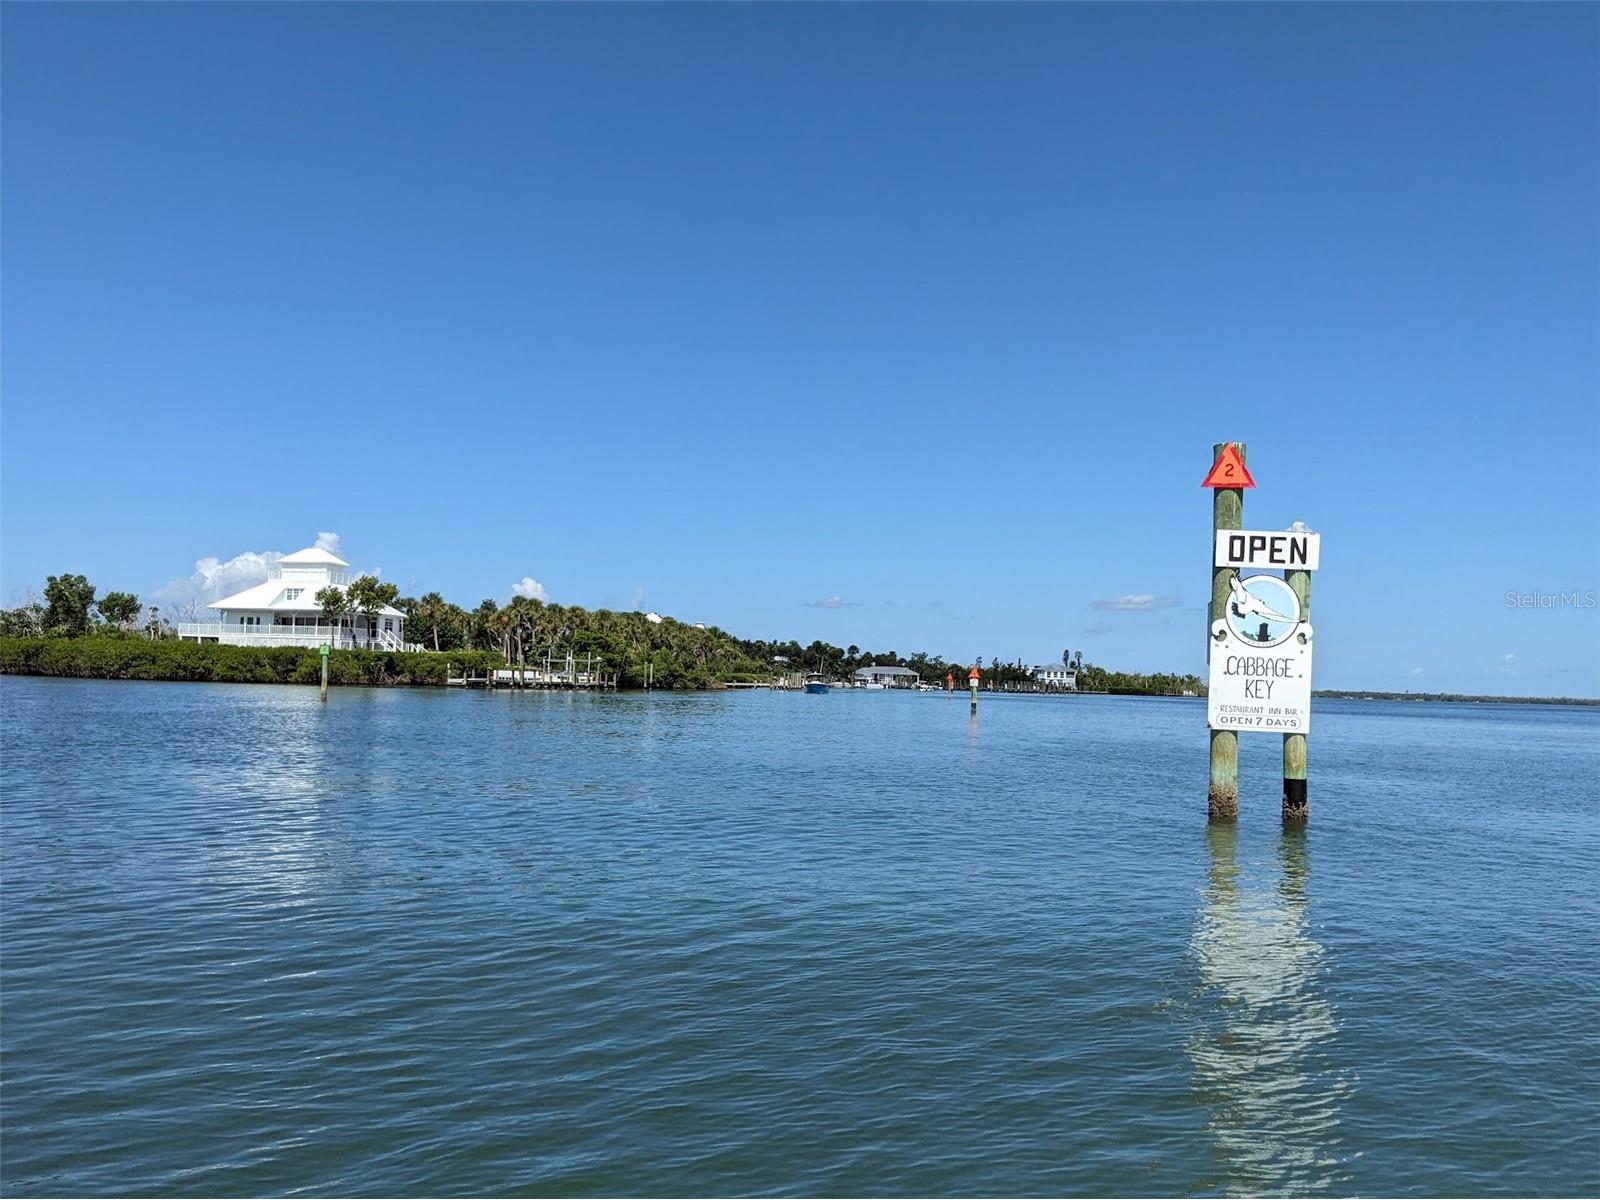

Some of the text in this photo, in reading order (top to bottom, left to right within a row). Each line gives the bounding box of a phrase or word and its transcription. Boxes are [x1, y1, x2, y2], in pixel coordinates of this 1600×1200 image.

[1225, 464, 1234, 476] 2
[1229, 535, 1307, 565] OPEN
[1226, 656, 1295, 678] CABBAGE
[1245, 679, 1274, 698] KEY
[1220, 705, 1264, 714] RESTAURANT
[1220, 716, 1297, 727] OPEN 7 DAYS
